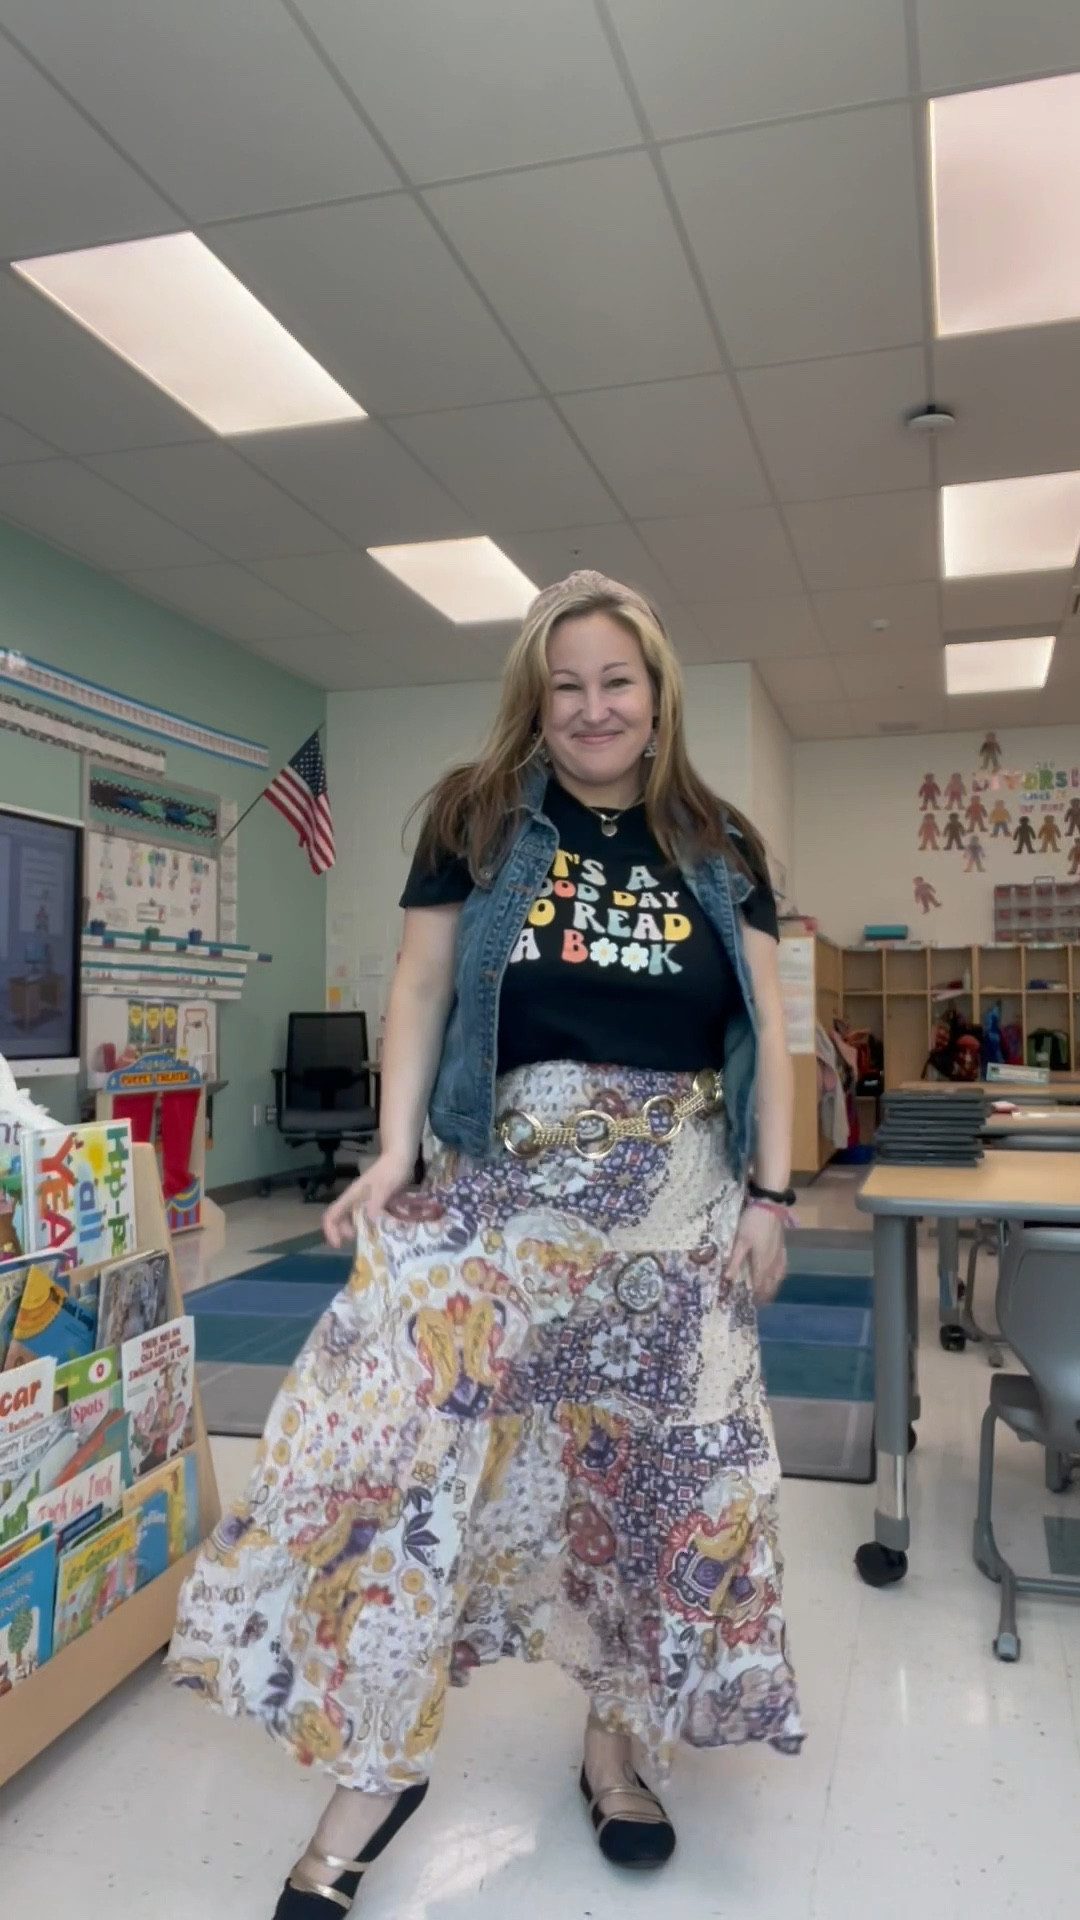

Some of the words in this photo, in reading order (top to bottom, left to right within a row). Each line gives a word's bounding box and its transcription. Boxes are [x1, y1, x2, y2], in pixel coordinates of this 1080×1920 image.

[552, 849, 607, 886] T'S
[626, 865, 660, 891] A
[537, 877, 600, 902] OOD
[612, 890, 680, 909] DAY
[527, 899, 556, 926] O
[572, 901, 692, 942] READ
[509, 928, 541, 963] A
[73, 1399, 104, 1424] Spots
